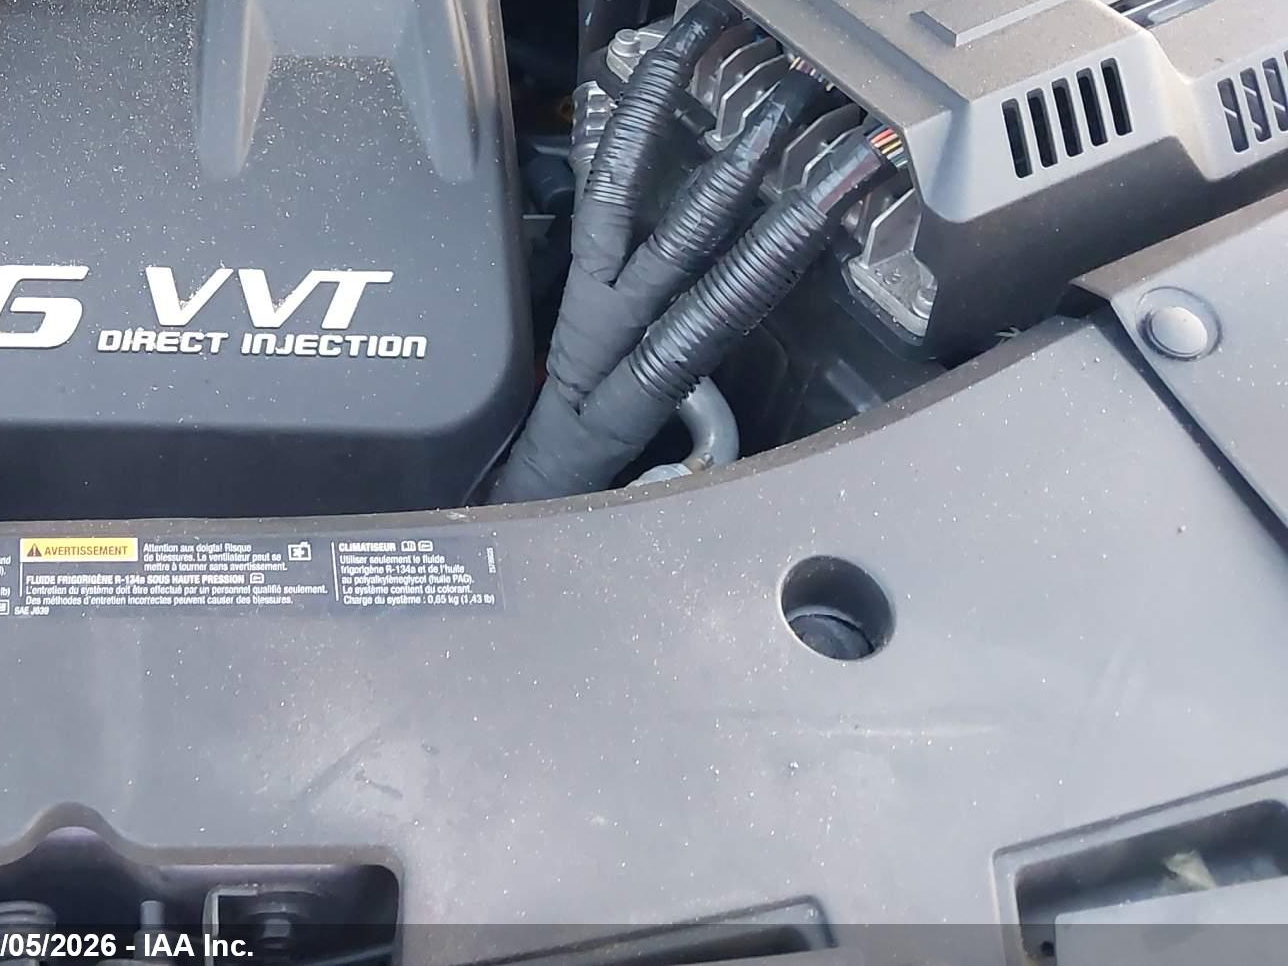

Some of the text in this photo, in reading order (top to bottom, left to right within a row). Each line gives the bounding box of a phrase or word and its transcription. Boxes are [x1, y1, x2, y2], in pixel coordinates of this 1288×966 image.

[144, 266, 394, 330] VVT
[96, 328, 427, 358] DIRECT INJECTION
[44, 546, 128, 555] AVERTISSEMENT
[143, 543, 178, 552] Attention
[224, 543, 252, 553] Risque
[338, 542, 396, 552] CLIMATISEUR
[26, 575, 55, 584] FLUIDE
[115, 575, 145, 584] R-134a
[147, 575, 170, 584] SOUS
[172, 575, 200, 584] HAUTE
[201, 575, 245, 584] PRESSION
